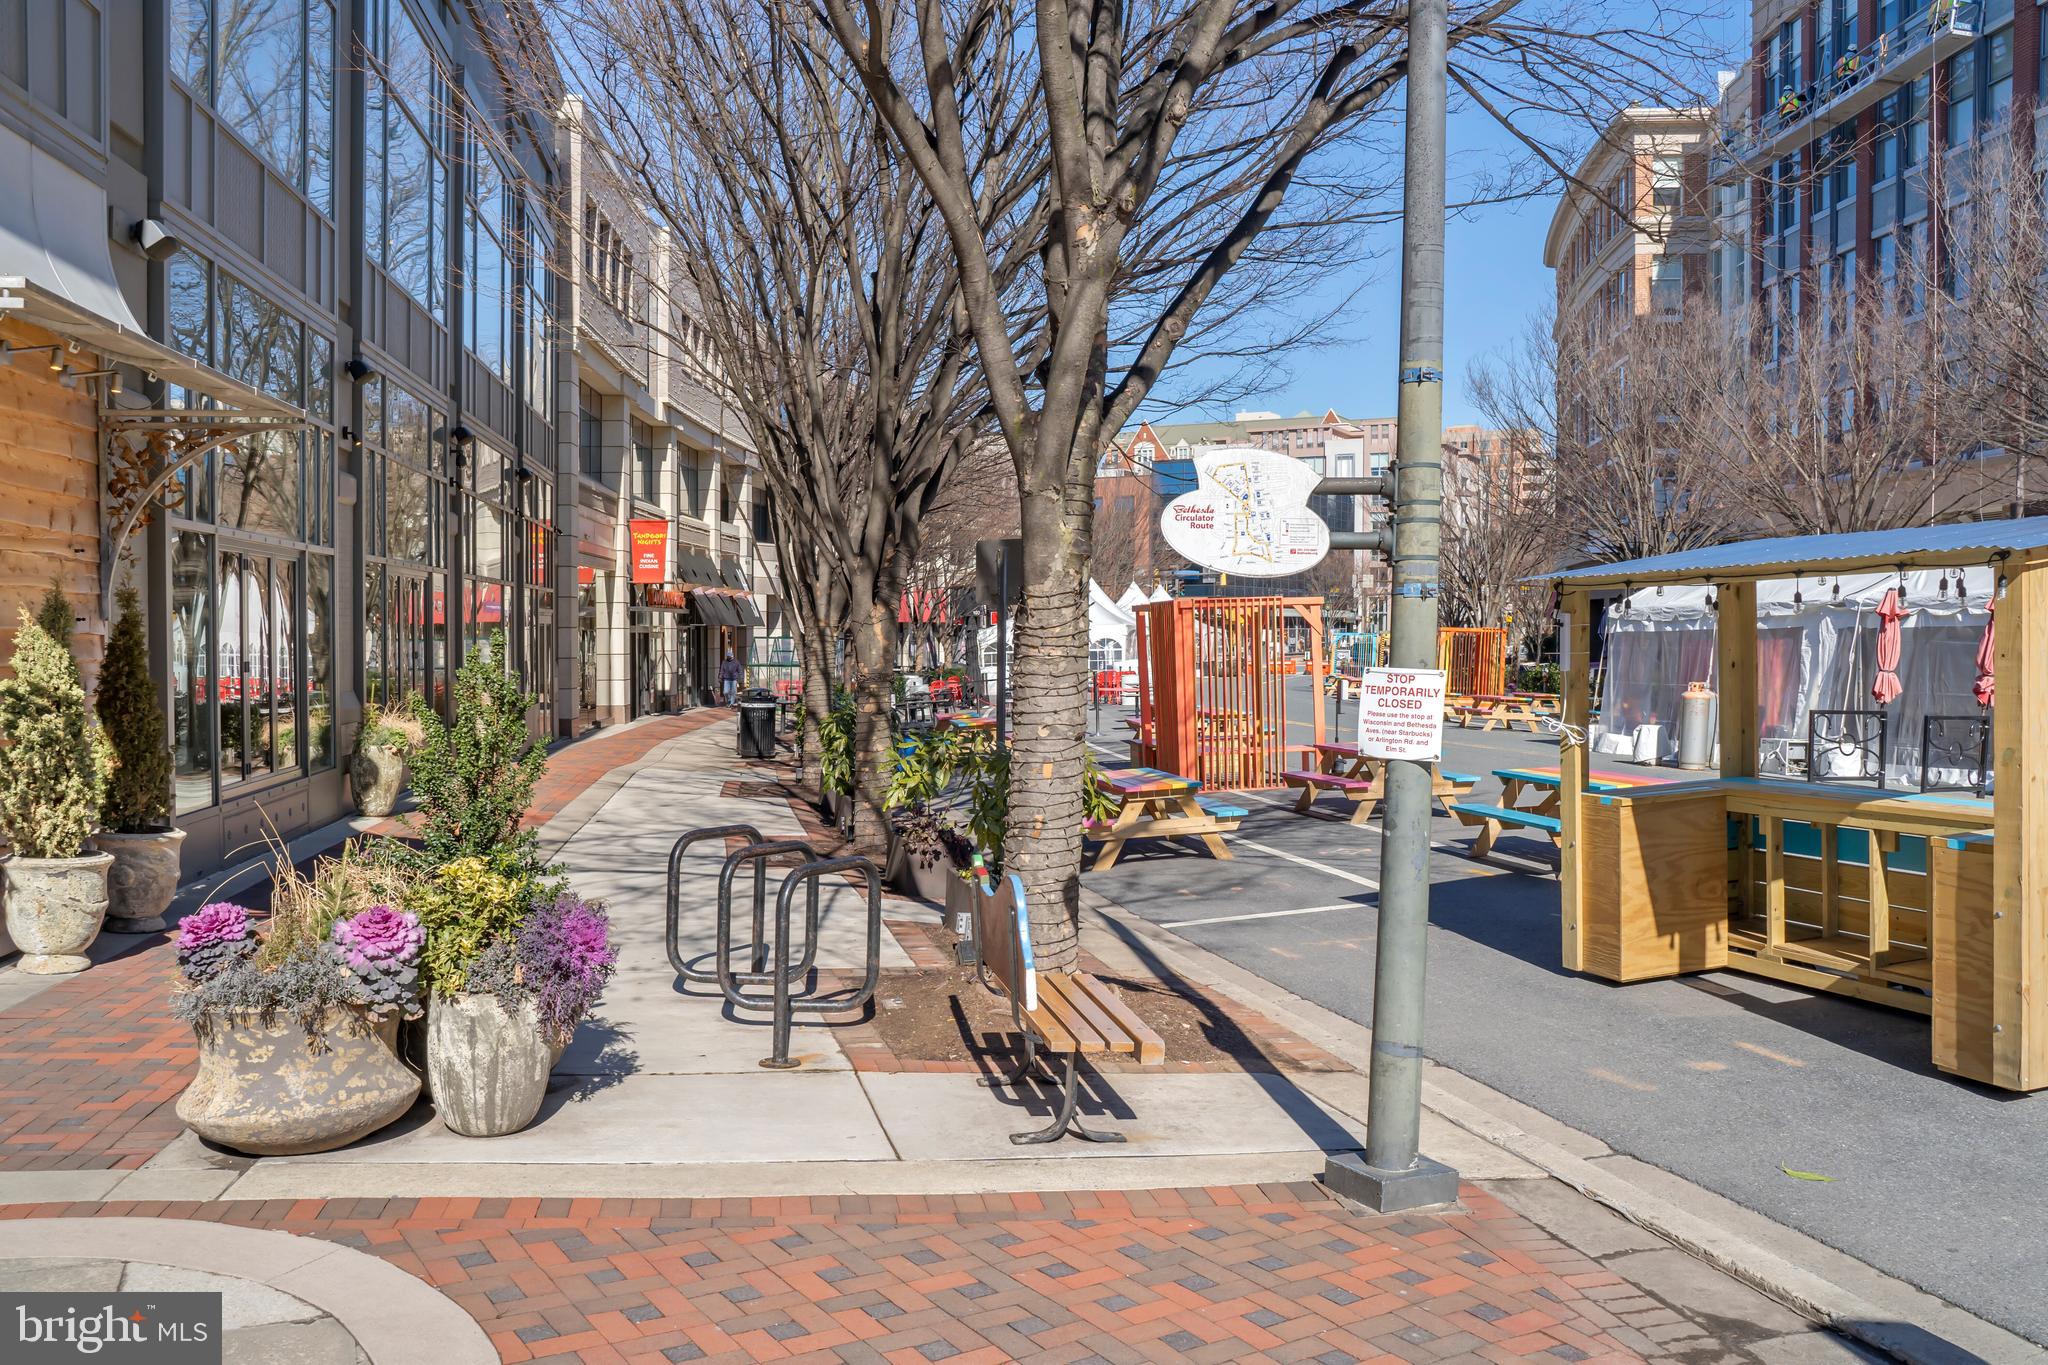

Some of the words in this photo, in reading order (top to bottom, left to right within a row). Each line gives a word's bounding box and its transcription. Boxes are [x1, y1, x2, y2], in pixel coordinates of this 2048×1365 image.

[1173, 504, 1215, 513] Bethesda
[1387, 673, 1416, 684] STOP
[1365, 685, 1440, 698] TEMPORARILY
[1378, 698, 1422, 709] CLOSED
[1363, 718, 1392, 726] Wisconsin
[1406, 721, 1437, 729] Bethesda
[1398, 729, 1433, 738] Starbucks)
[1375, 737, 1402, 745] Arlington
